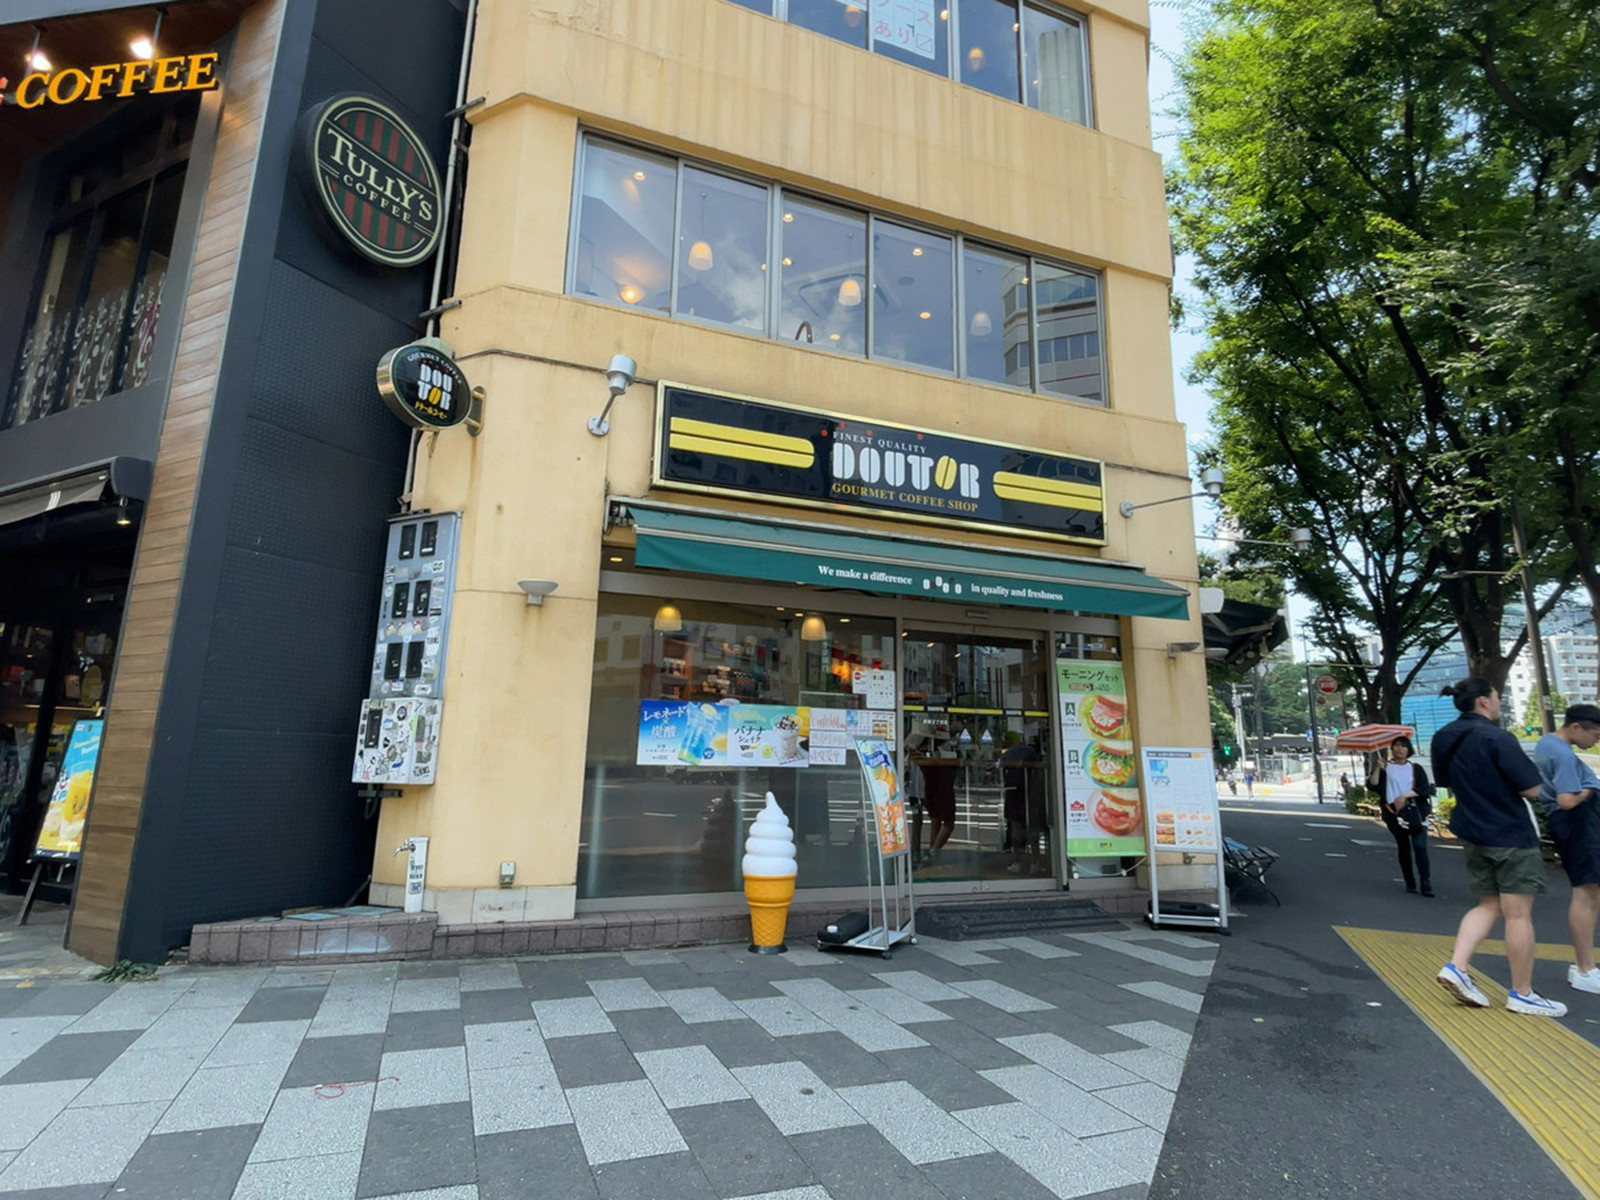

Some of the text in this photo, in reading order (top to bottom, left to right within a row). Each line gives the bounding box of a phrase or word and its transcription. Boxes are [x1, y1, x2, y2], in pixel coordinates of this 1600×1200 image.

[16, 53, 218, 109] COFFEE
[327, 128, 432, 222] TULLY'S
[343, 174, 411, 224] COFFEE
[833, 431, 927, 454] FINEST QUALITY
[833, 442, 980, 499] DOUTOR
[832, 482, 979, 513] GOURMET COFFEE SHOP
[818, 565, 912, 585] We make a difference
[971, 583, 1064, 601] in quality and freshness
[643, 704, 689, 721] レモネード
